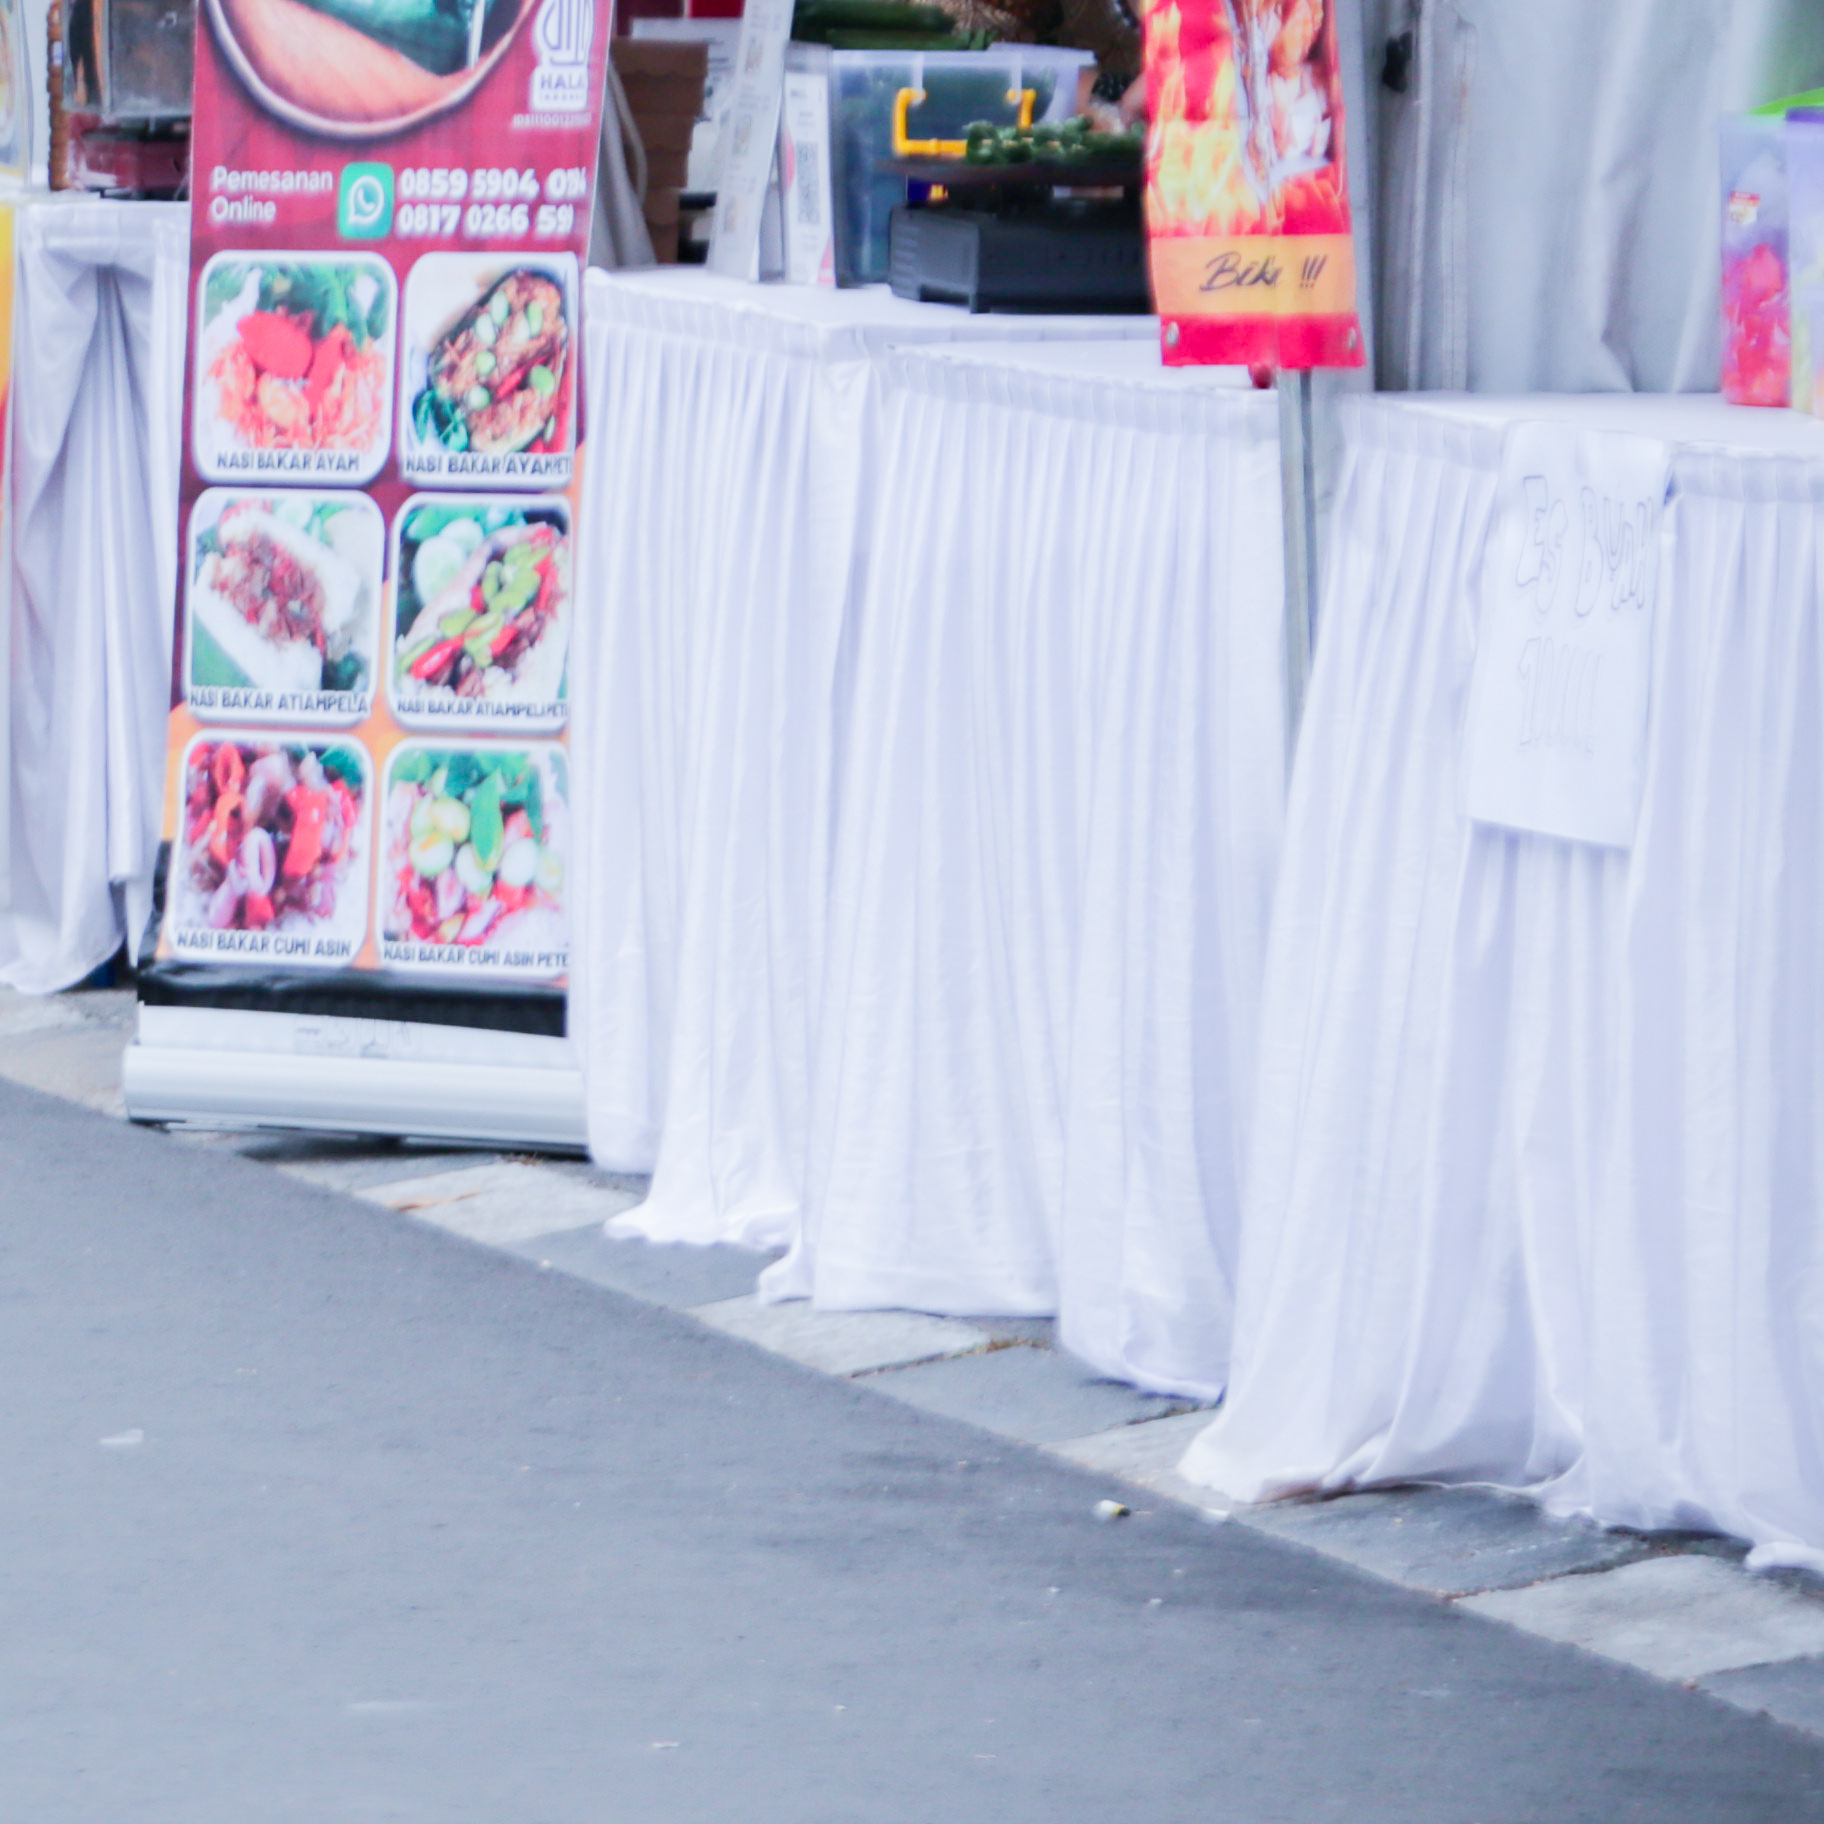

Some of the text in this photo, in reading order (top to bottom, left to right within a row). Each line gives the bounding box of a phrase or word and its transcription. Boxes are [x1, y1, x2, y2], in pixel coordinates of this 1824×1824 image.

[212, 166, 333, 192] Pemesanan
[401, 168, 468, 198] 0859
[473, 168, 540, 200] 5904
[211, 196, 277, 221] Online
[398, 204, 460, 234] 0817
[465, 204, 530, 234] 0266
[217, 452, 360, 472] NASI BAKAR AYAM
[406, 456, 442, 474] NASI
[448, 457, 502, 475] BAKAR
[190, 690, 217, 708] NASI
[222, 692, 274, 710] BAKAR
[428, 700, 473, 715] BAKAR
[177, 931, 351, 957] NASI BAKAR CUMI ASIN
[383, 943, 415, 961] NASI
[418, 945, 465, 963] BAKAR
[469, 949, 500, 965] CUMI
[503, 950, 534, 966] ASIN
